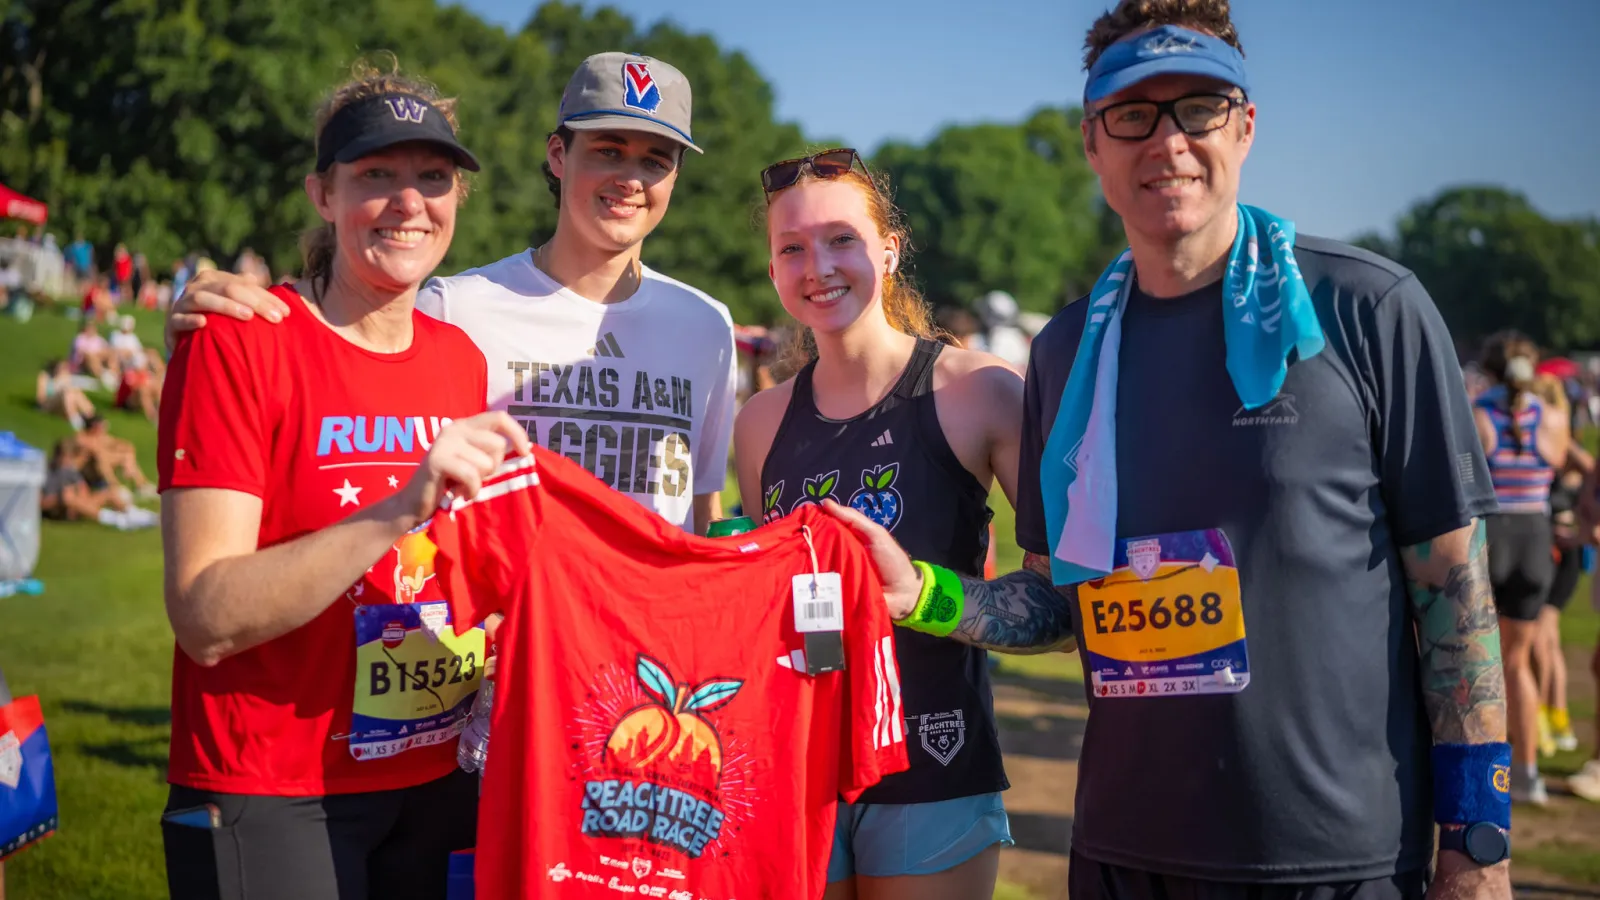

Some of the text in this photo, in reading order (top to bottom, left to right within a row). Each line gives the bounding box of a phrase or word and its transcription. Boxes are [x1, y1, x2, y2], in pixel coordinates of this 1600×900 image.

[385, 97, 427, 123] W
[507, 361, 693, 418] TEXAS A&M
[316, 416, 453, 456] RUNU
[1091, 592, 1223, 635] E25688
[370, 652, 476, 696] B15523
[1110, 685, 1118, 694] XS
[1121, 685, 1125, 694] S
[1129, 685, 1136, 694] M
[1149, 684, 1158, 693] XL
[1163, 682, 1176, 692] 2X
[1182, 681, 1195, 691] 3X
[375, 745, 387, 754] XS
[391, 743, 396, 752] S
[426, 734, 436, 743] 2X
[918, 720, 965, 733] PEACHTREE
[582, 780, 725, 840] PEACHTREE
[581, 809, 709, 857] ROAD RACE
